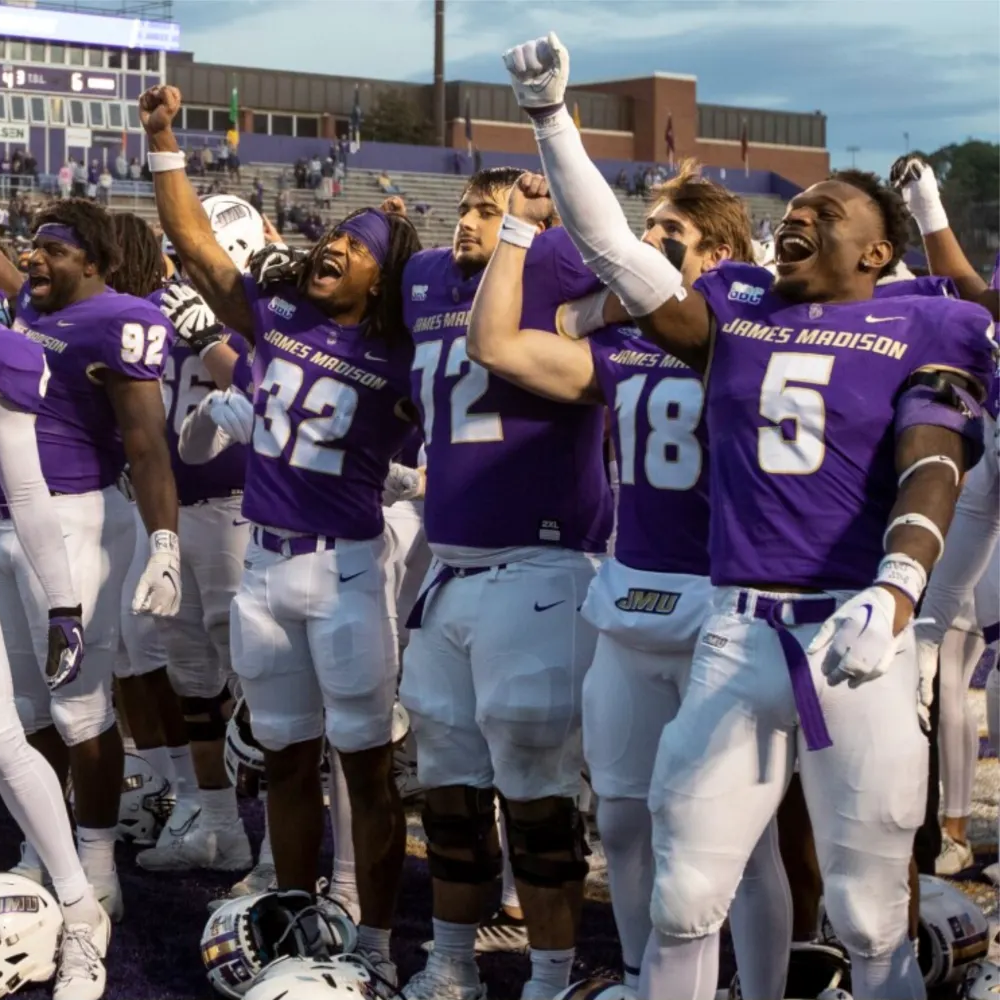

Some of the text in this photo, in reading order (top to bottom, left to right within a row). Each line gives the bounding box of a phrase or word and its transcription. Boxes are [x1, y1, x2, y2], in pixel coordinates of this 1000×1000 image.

[120, 321, 168, 366] 92
[263, 328, 388, 391] JAMES MADISON
[608, 349, 661, 368] JAMES
[721, 317, 909, 361] JAMES MADISON
[252, 357, 359, 477] 32
[411, 335, 505, 446] 72
[756, 351, 836, 475] 5
[613, 372, 705, 491] 18
[615, 587, 683, 616] JMU
